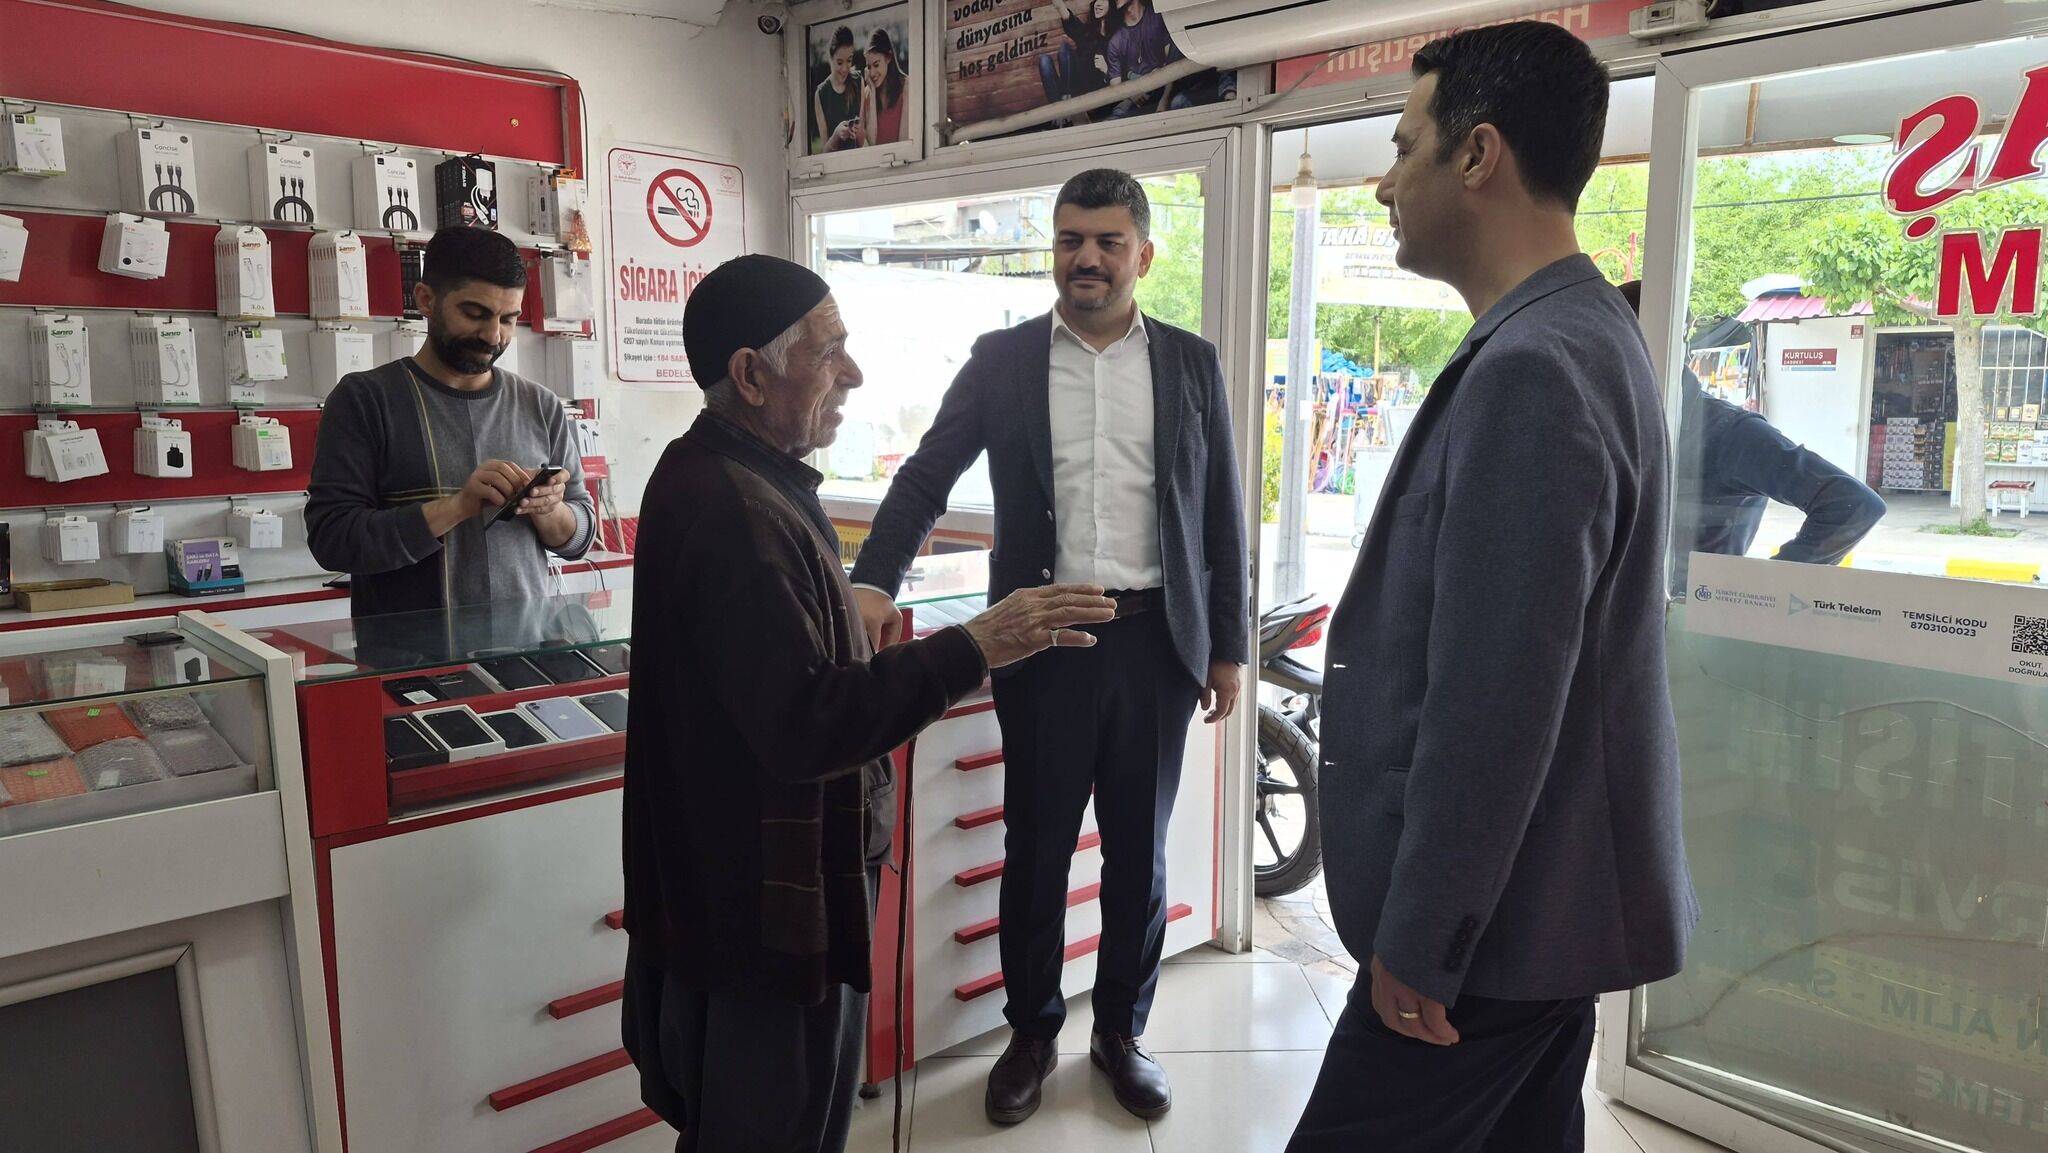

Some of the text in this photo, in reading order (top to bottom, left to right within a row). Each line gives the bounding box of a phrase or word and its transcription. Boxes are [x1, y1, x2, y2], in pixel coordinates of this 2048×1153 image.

[956, 7, 1033, 50] dünyasına
[959, 31, 1049, 79] hoş geldiniz
[619, 257, 679, 303] SİGARA
[1784, 351, 1824, 360] KURTULUŞ
[656, 369, 691, 378] BEDELS
[1813, 600, 1836, 610] Türk
[1838, 603, 1882, 616] Telekom
[1902, 610, 1988, 628] TEMSİLCİ KODU
[1910, 621, 1977, 637] 8703100023
